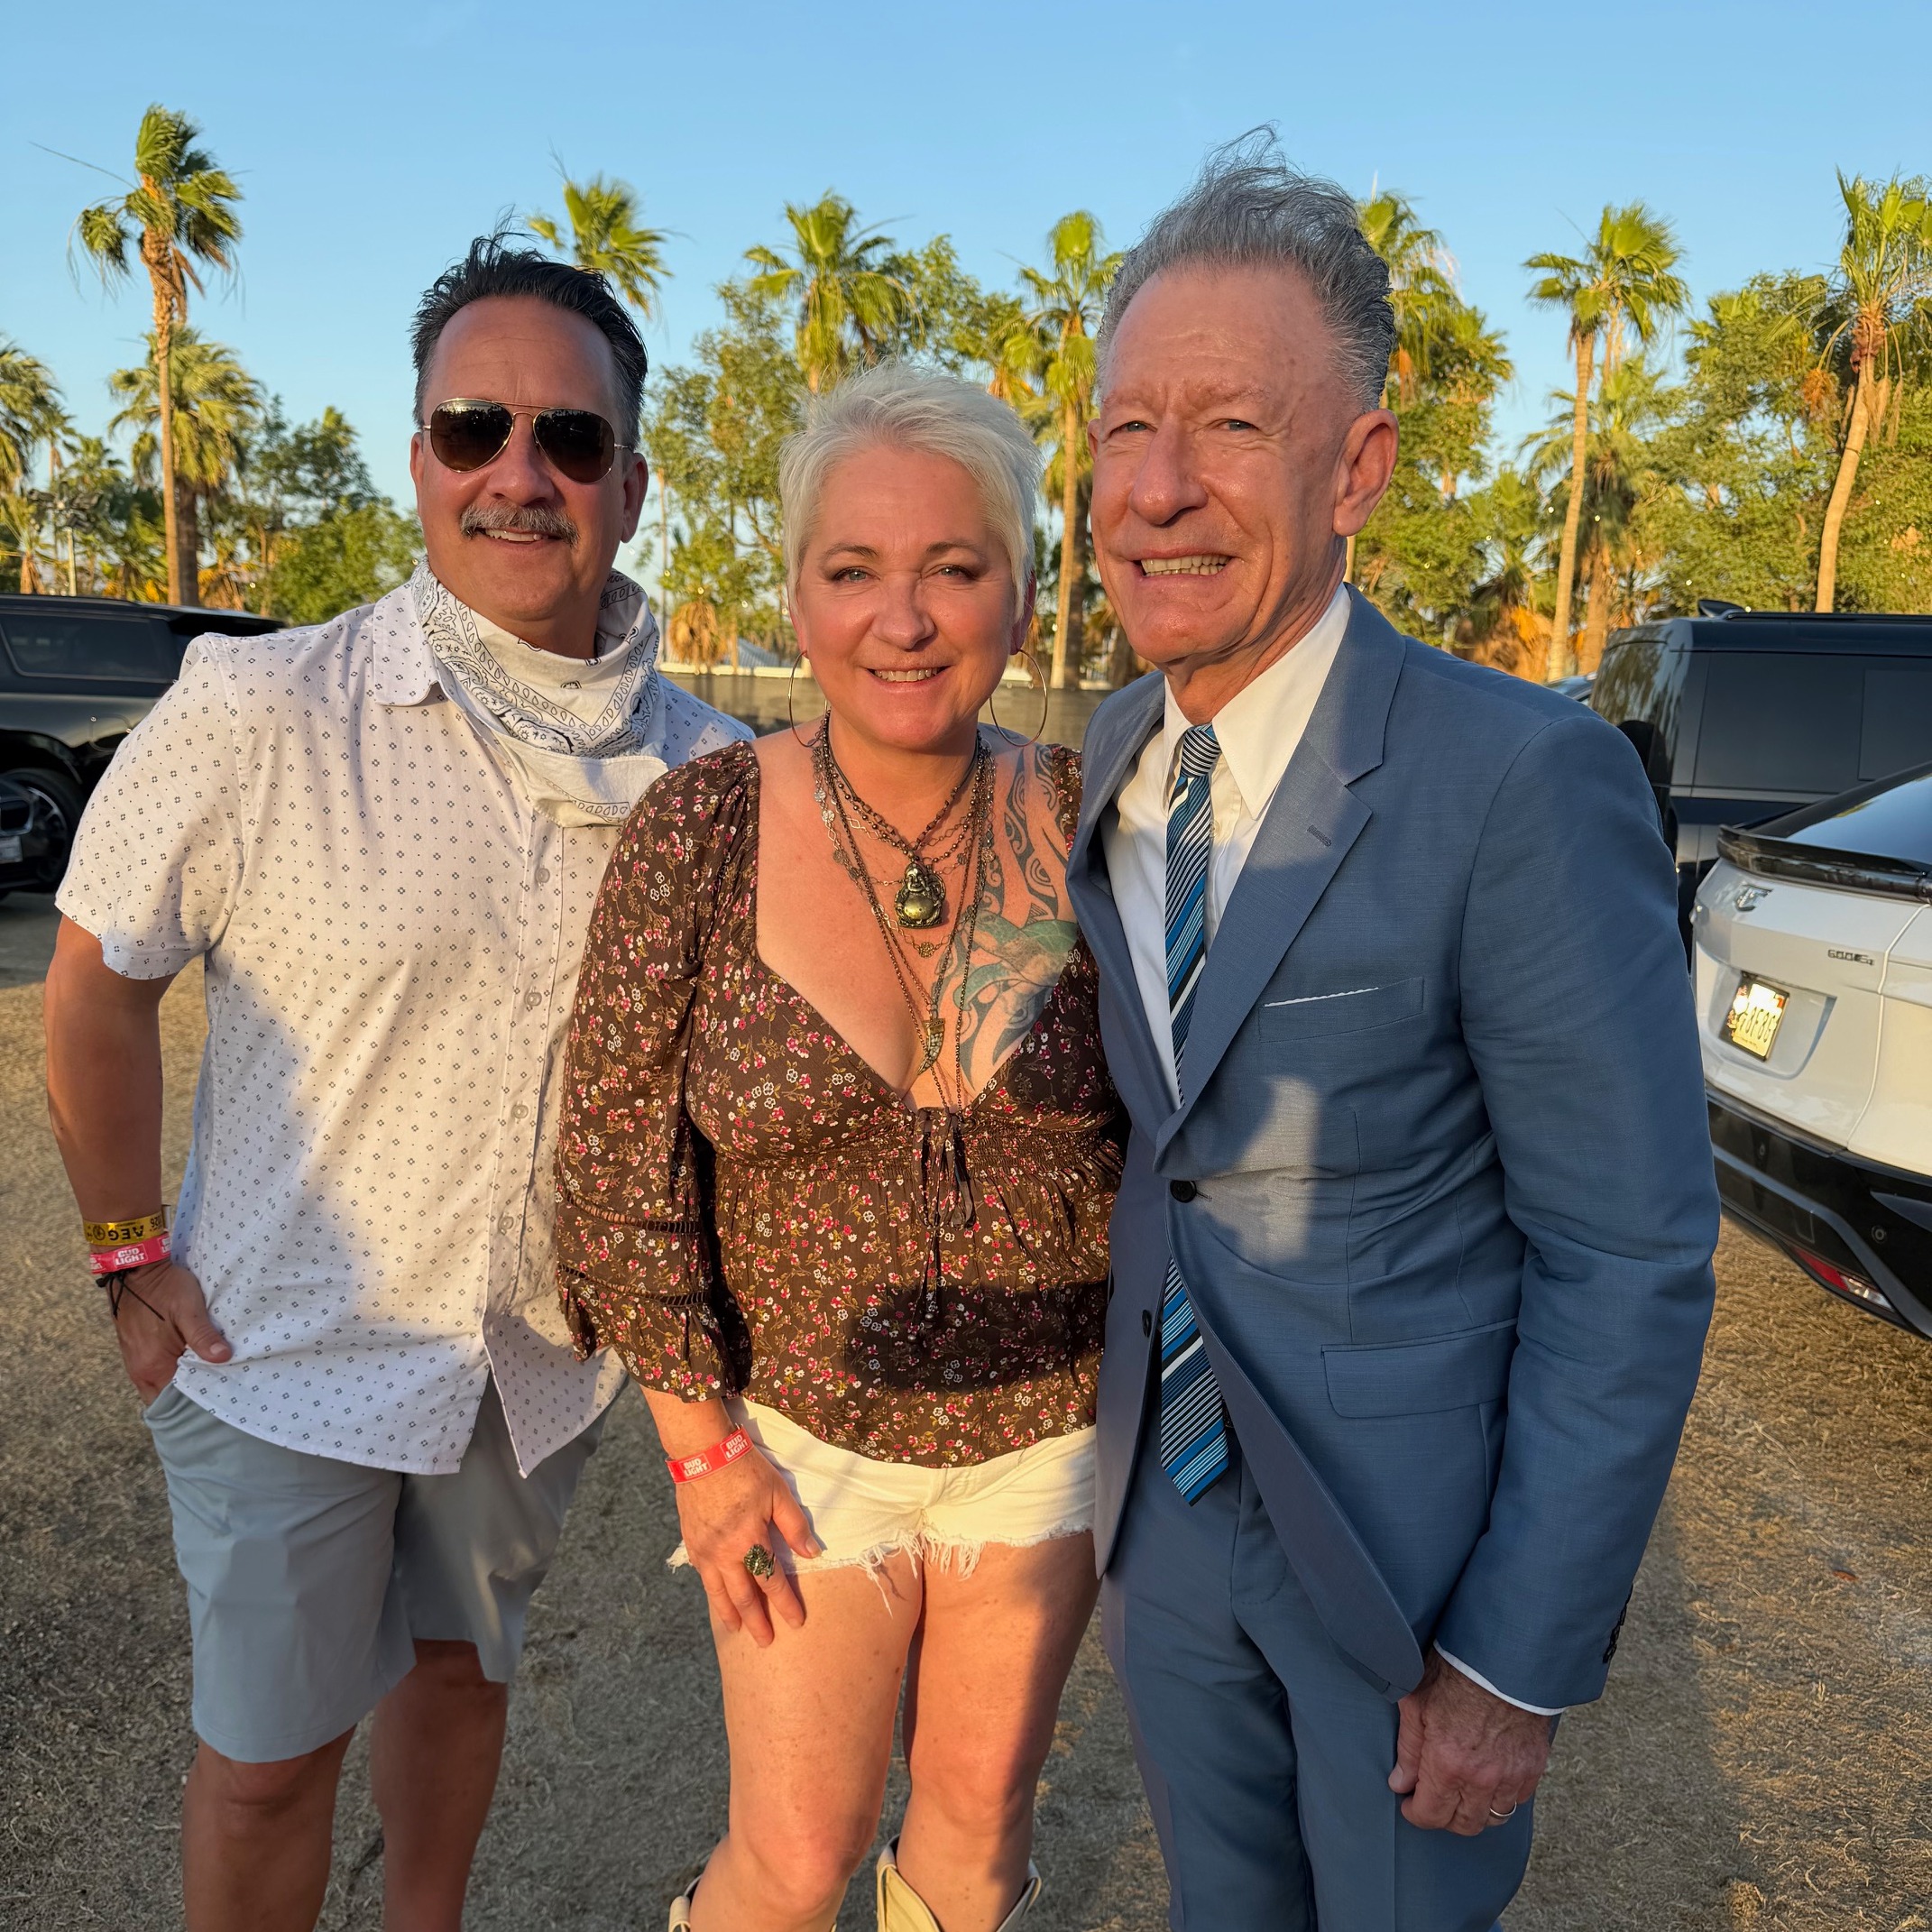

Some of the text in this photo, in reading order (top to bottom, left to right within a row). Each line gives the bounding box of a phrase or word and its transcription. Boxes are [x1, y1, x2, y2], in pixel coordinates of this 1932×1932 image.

[108, 1225, 143, 1241] AEG
[115, 1253, 145, 1265] LIGHT
[117, 1247, 140, 1258] BUD
[725, 1439, 749, 1458] LIGHT
[726, 1434, 743, 1449] BUD
[683, 1458, 702, 1470] BUD
[684, 1462, 709, 1477] LIGHT
